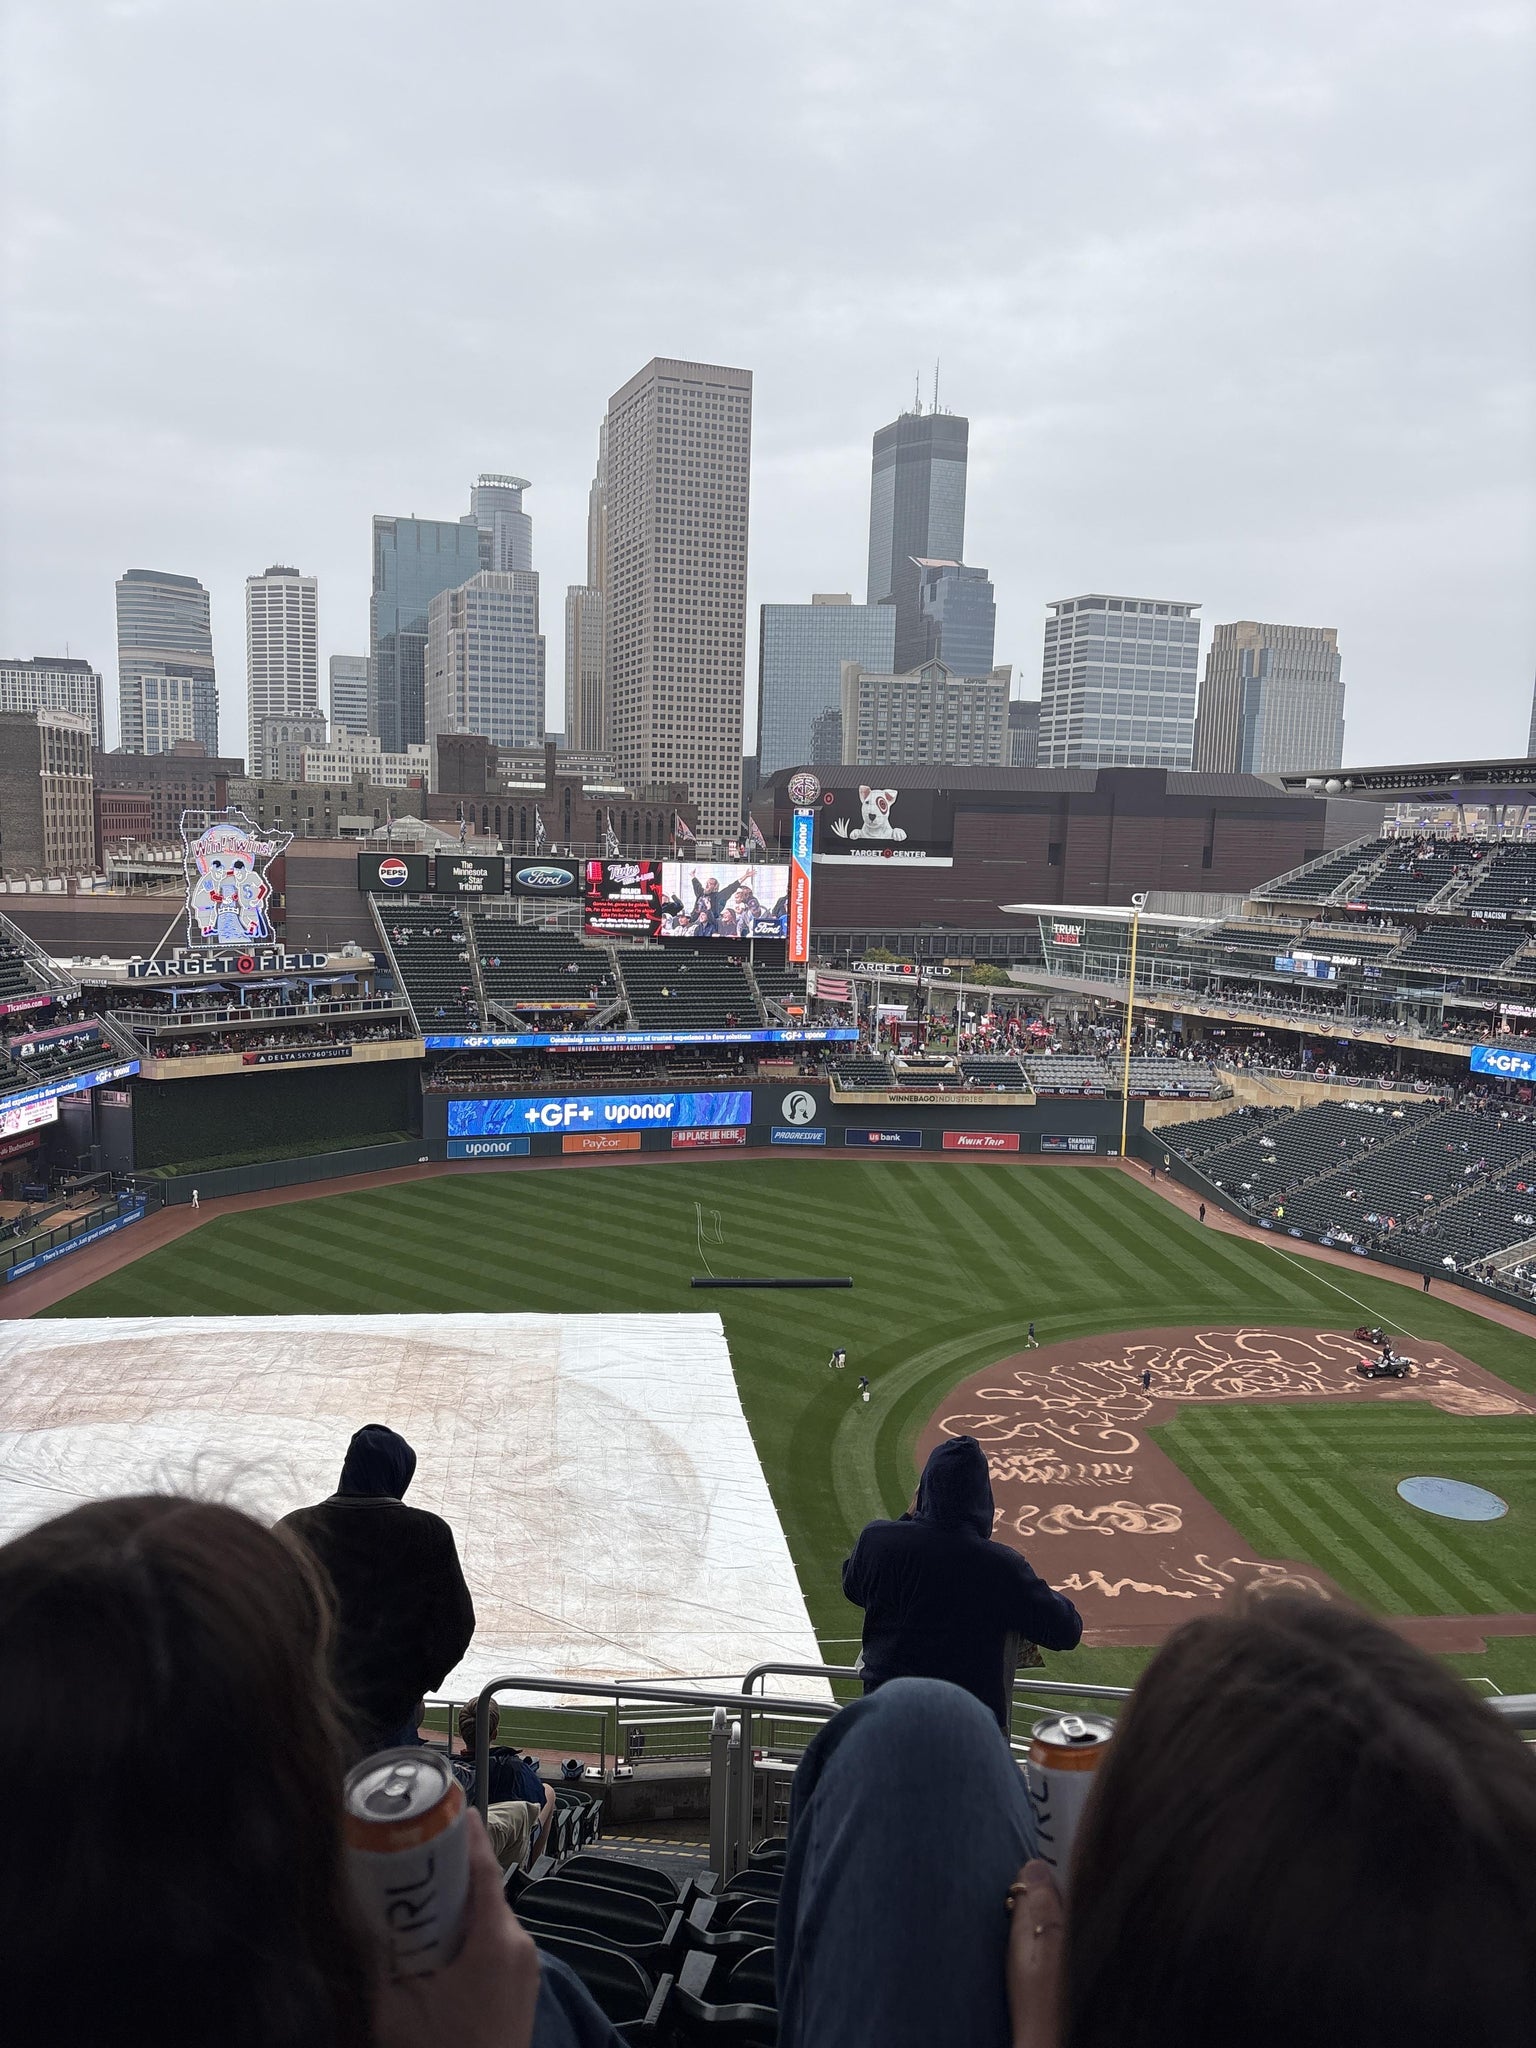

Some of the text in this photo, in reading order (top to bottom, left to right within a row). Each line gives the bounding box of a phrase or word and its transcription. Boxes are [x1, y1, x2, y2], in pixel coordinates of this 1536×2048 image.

[798, 822, 808, 858] uponor
[850, 849, 927, 858] TARGET CENTER
[461, 860, 473, 869] The
[380, 869, 407, 877] PEPSI
[453, 867, 488, 877] Minnesota
[468, 876, 484, 884] Star
[527, 870, 562, 886] Ford
[458, 883, 484, 891] Tribune
[795, 878, 805, 956] uponor.com/twins
[1471, 910, 1507, 920] END RACISM
[754, 921, 781, 935] Ford
[1053, 924, 1082, 935] TRULY
[130, 953, 329, 978] TARGET FIELD
[850, 962, 901, 973] TARGET
[491, 1037, 518, 1046] uponor
[550, 1035, 583, 1044] Combining
[673, 1033, 704, 1042] experience
[712, 1033, 725, 1041] flow
[804, 1031, 828, 1040] uponor
[1486, 1055, 1531, 1072] +GF+
[12, 1093, 39, 1106] experience
[56, 1082, 78, 1093] solutions
[113, 1065, 131, 1077] uponor
[1059, 1087, 1080, 1095] Corona
[1159, 1090, 1180, 1098] Corona
[1188, 1090, 1210, 1098] Corona
[888, 1095, 984, 1103] WINNEBAGO INDUSTRIES
[524, 1102, 675, 1127] +GF+ uponor
[686, 1131, 709, 1141] PLACE
[721, 1130, 740, 1140] HERE
[774, 1131, 824, 1141] PROGRESSIVE
[868, 1133, 901, 1142] us bank
[582, 1138, 620, 1149] Paycor
[983, 1137, 1005, 1147] TRIP
[465, 1141, 512, 1156] uponor
[42, 1250, 59, 1262] There's
[87, 1232, 99, 1243] great
